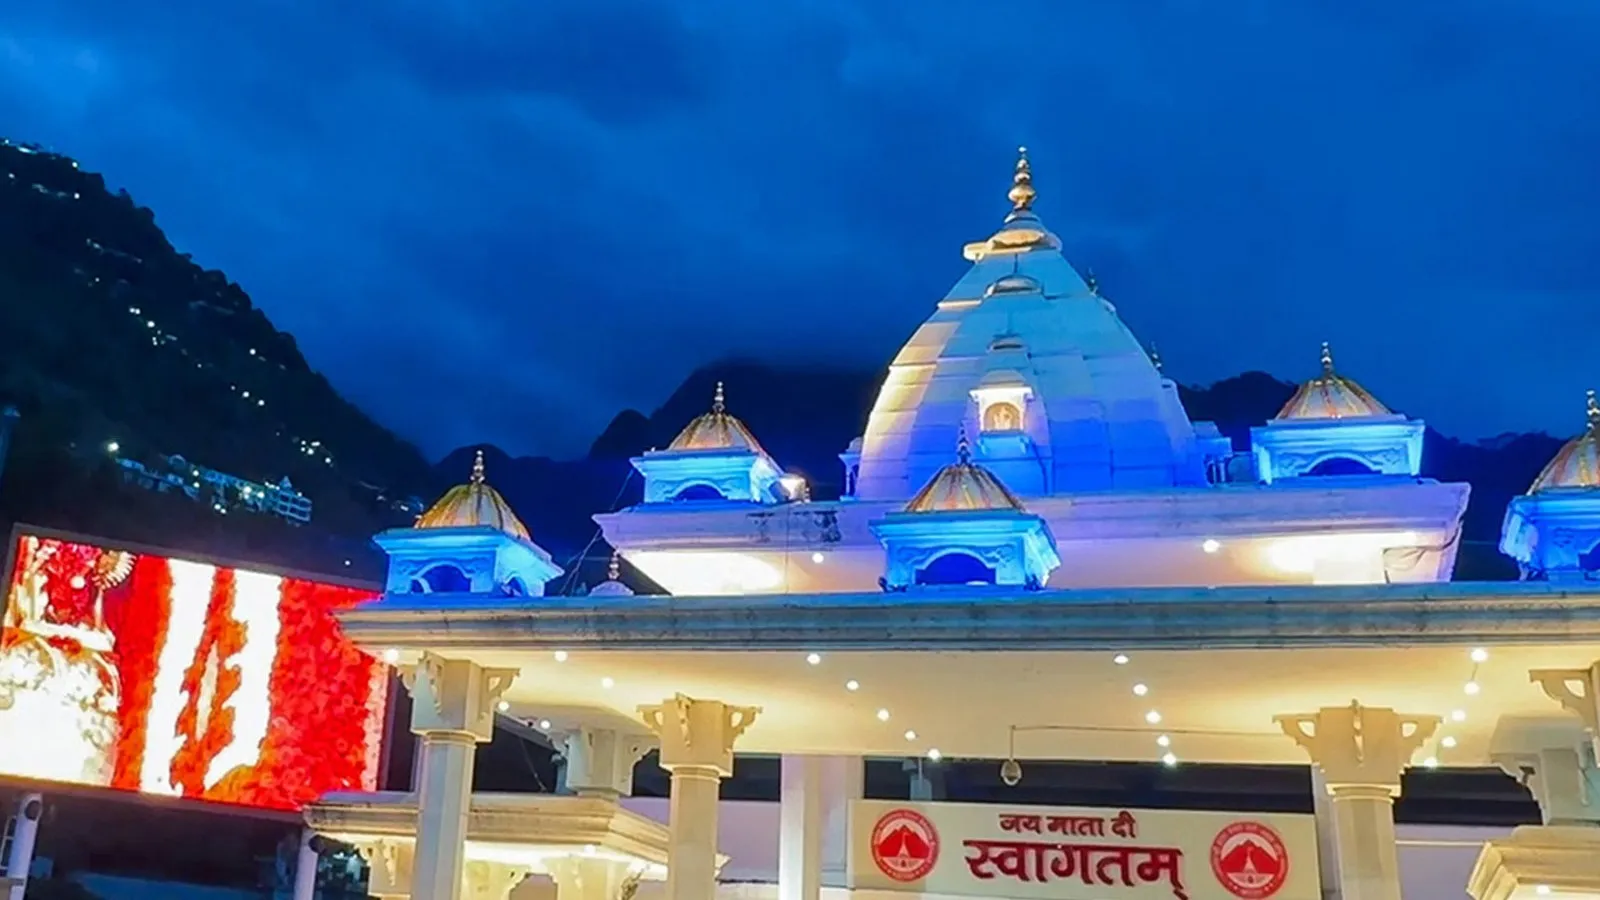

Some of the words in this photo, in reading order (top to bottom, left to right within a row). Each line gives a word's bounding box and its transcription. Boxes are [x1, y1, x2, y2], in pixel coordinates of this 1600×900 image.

[999, 813, 1041, 834] जय
[1047, 815, 1105, 837] माता
[1111, 810, 1136, 838] दी
[963, 840, 1188, 900] स्वागतम्
